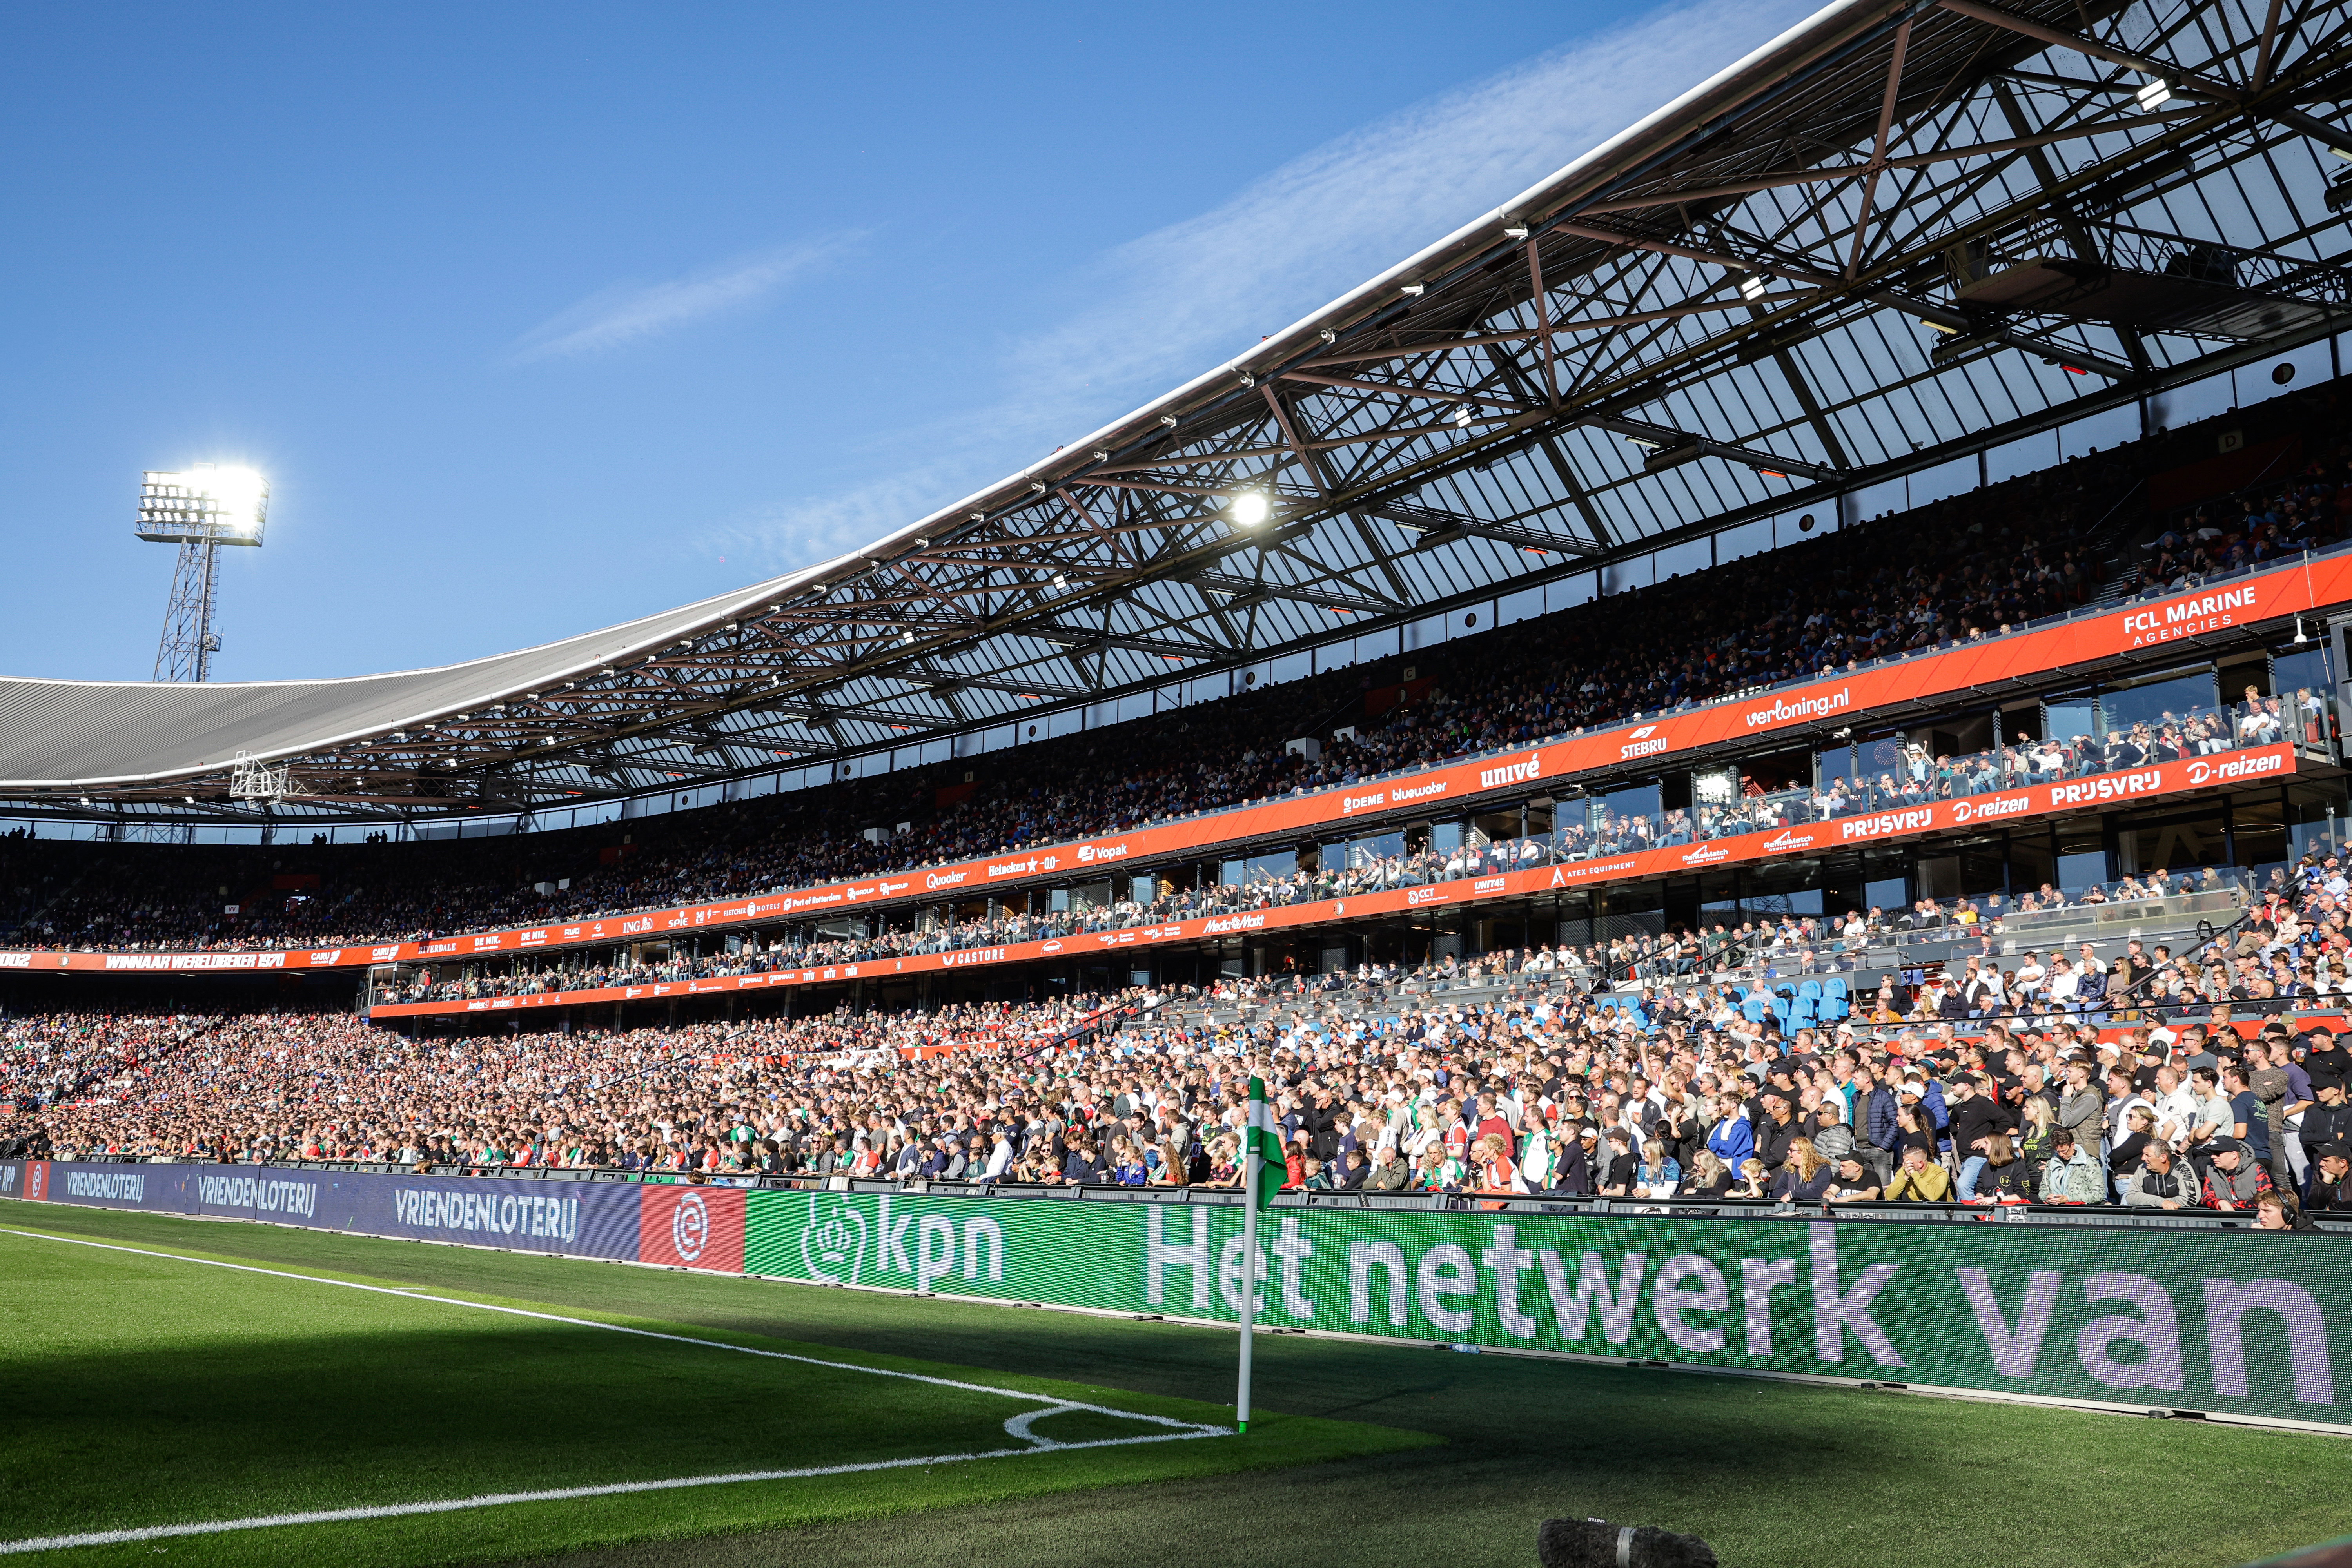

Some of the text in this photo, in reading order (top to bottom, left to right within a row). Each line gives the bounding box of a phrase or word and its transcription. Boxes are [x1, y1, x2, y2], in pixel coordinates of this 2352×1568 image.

[2225, 435, 2236, 447] D
[2124, 586, 2256, 636] FCL MARINE
[2133, 613, 2233, 647] AGENCIES
[1746, 687, 1849, 727] verloning.nl
[1621, 737, 1666, 759] STEBRU
[1480, 753, 1539, 788] univé
[2187, 752, 2281, 784] D-reizen
[1392, 781, 1447, 801] bluewater
[1352, 793, 1384, 809] DEME
[1953, 797, 2029, 822] D-reizen
[1762, 835, 1813, 848] RentalMatch
[1096, 843, 1127, 860] Vopak
[1682, 849, 1728, 862] RentalMatch
[988, 862, 1026, 877] Heineken
[1567, 861, 1635, 877] ATEX EQUIPMENT
[889, 882, 908, 891] GROUP
[926, 871, 967, 889] Quooker
[1475, 878, 1505, 890] UNIT45
[793, 893, 841, 907] Port of Rotterdam
[1419, 888, 1434, 898] CCT
[724, 908, 746, 916] FLETCHER
[757, 902, 780, 912] HOTELS
[622, 920, 641, 934] ING
[475, 937, 484, 946] DE
[521, 932, 530, 941] DE
[311, 952, 330, 960] CARU
[372, 947, 389, 956] CARU
[418, 943, 456, 954] RIVERDALE
[958, 948, 1004, 964] CASTORE
[0, 953, 31, 967] 002
[105, 953, 285, 969] WINNAAR WERELDBEKER 1970
[467, 1001, 485, 1010] Jordex
[492, 998, 510, 1008] Jordex
[3, 1166, 15, 1192] APP
[67, 1172, 145, 1203] VRIENDENLOTERIJ
[198, 1176, 317, 1218] VRIENDENLOTERIJ
[395, 1189, 577, 1243] VRIENDENLOTERIJ
[877, 1193, 1003, 1293] kpn
[1146, 1204, 2335, 1406] Het netwerk van
